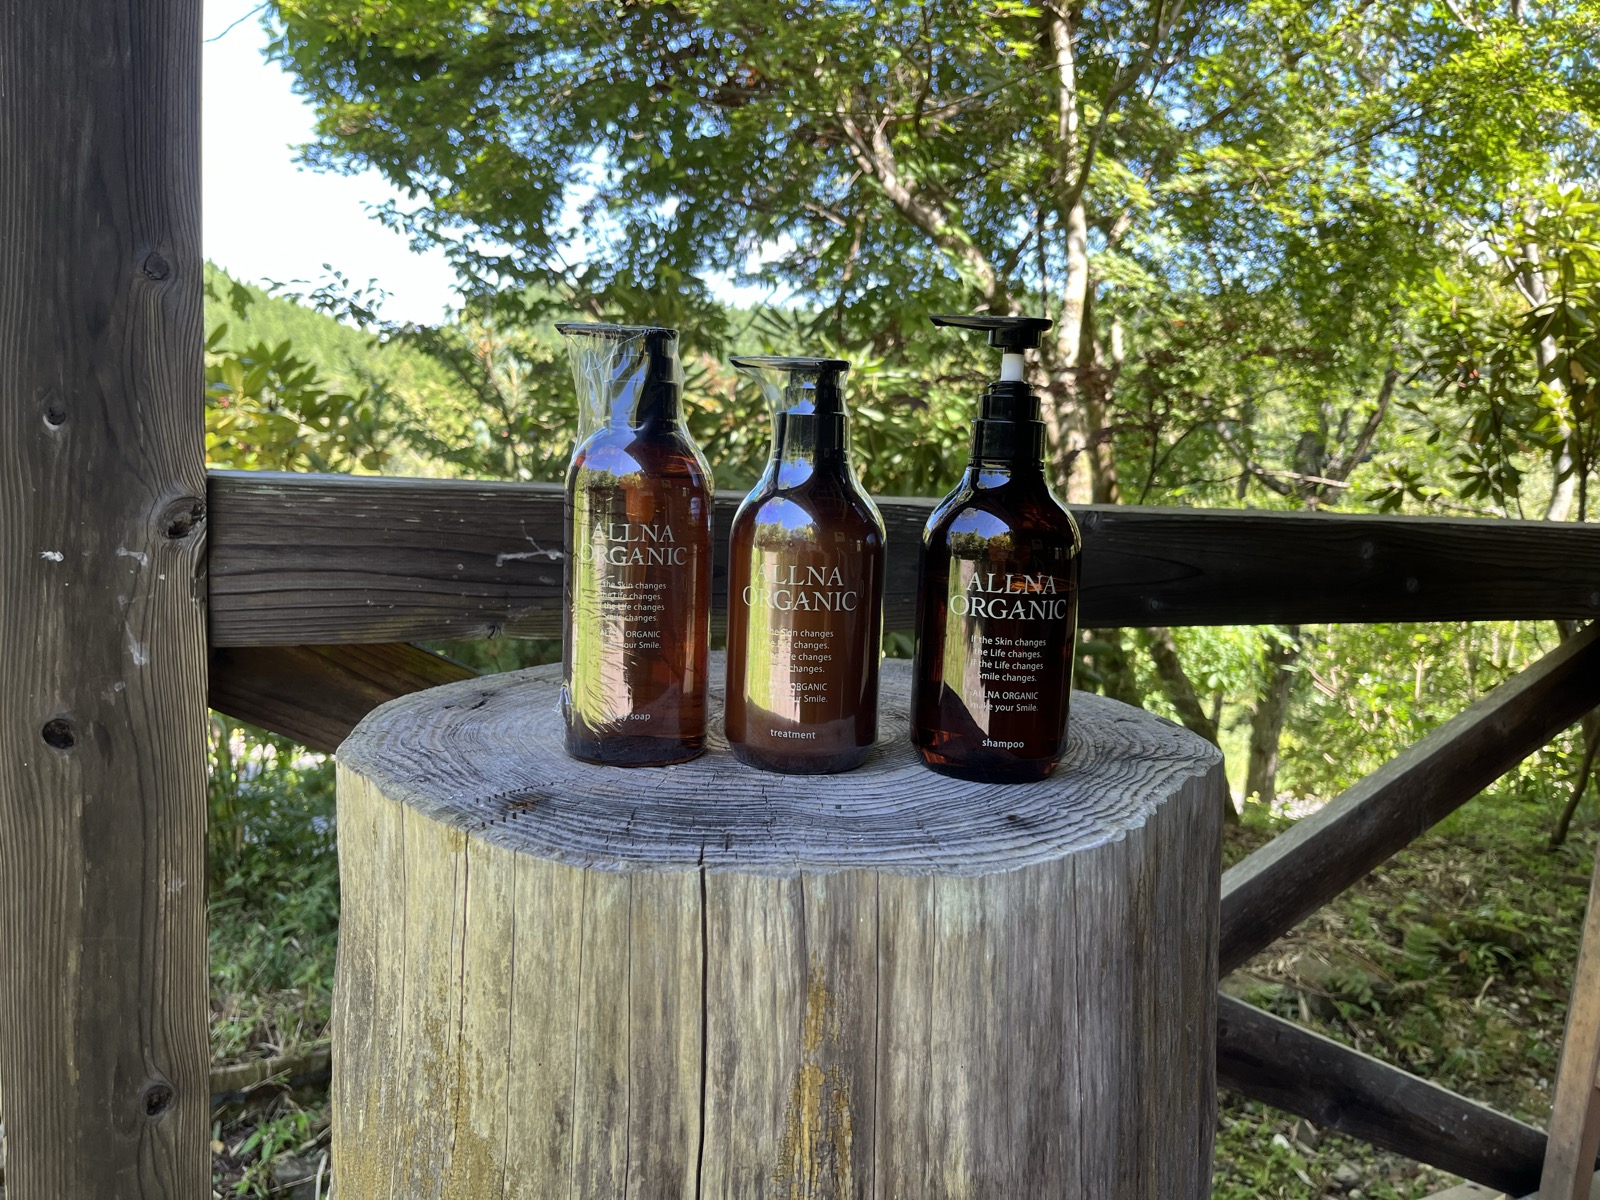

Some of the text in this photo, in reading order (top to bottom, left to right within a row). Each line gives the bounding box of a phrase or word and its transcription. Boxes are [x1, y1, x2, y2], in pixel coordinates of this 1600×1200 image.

[591, 521, 675, 542] ALLNA
[580, 543, 687, 566] ORGANIC
[755, 563, 844, 586] ALLNA
[617, 581, 633, 589] Skin
[635, 582, 666, 590] changes
[966, 572, 1057, 594] ALLNA
[629, 592, 662, 601] changes.
[742, 586, 857, 612] ORGANIC
[634, 604, 665, 612] changes
[950, 594, 1066, 620] ORGANIC
[625, 614, 658, 623] changes.
[800, 630, 834, 639] changes
[794, 641, 830, 650] changes.
[978, 636, 992, 644] the
[995, 637, 1012, 646] Skin
[1015, 638, 1046, 648] changes
[798, 653, 832, 662] changes
[974, 648, 1042, 660] the Life changes.
[790, 664, 825, 674] changes.
[978, 660, 992, 668] the
[995, 661, 1010, 670] Life
[1012, 662, 1044, 672] changes
[978, 672, 1036, 683] Smile changes.
[1002, 692, 1038, 700] ORGANIC
[995, 704, 1014, 712] your
[770, 728, 816, 739] treatment
[982, 738, 1024, 750] shampoo
